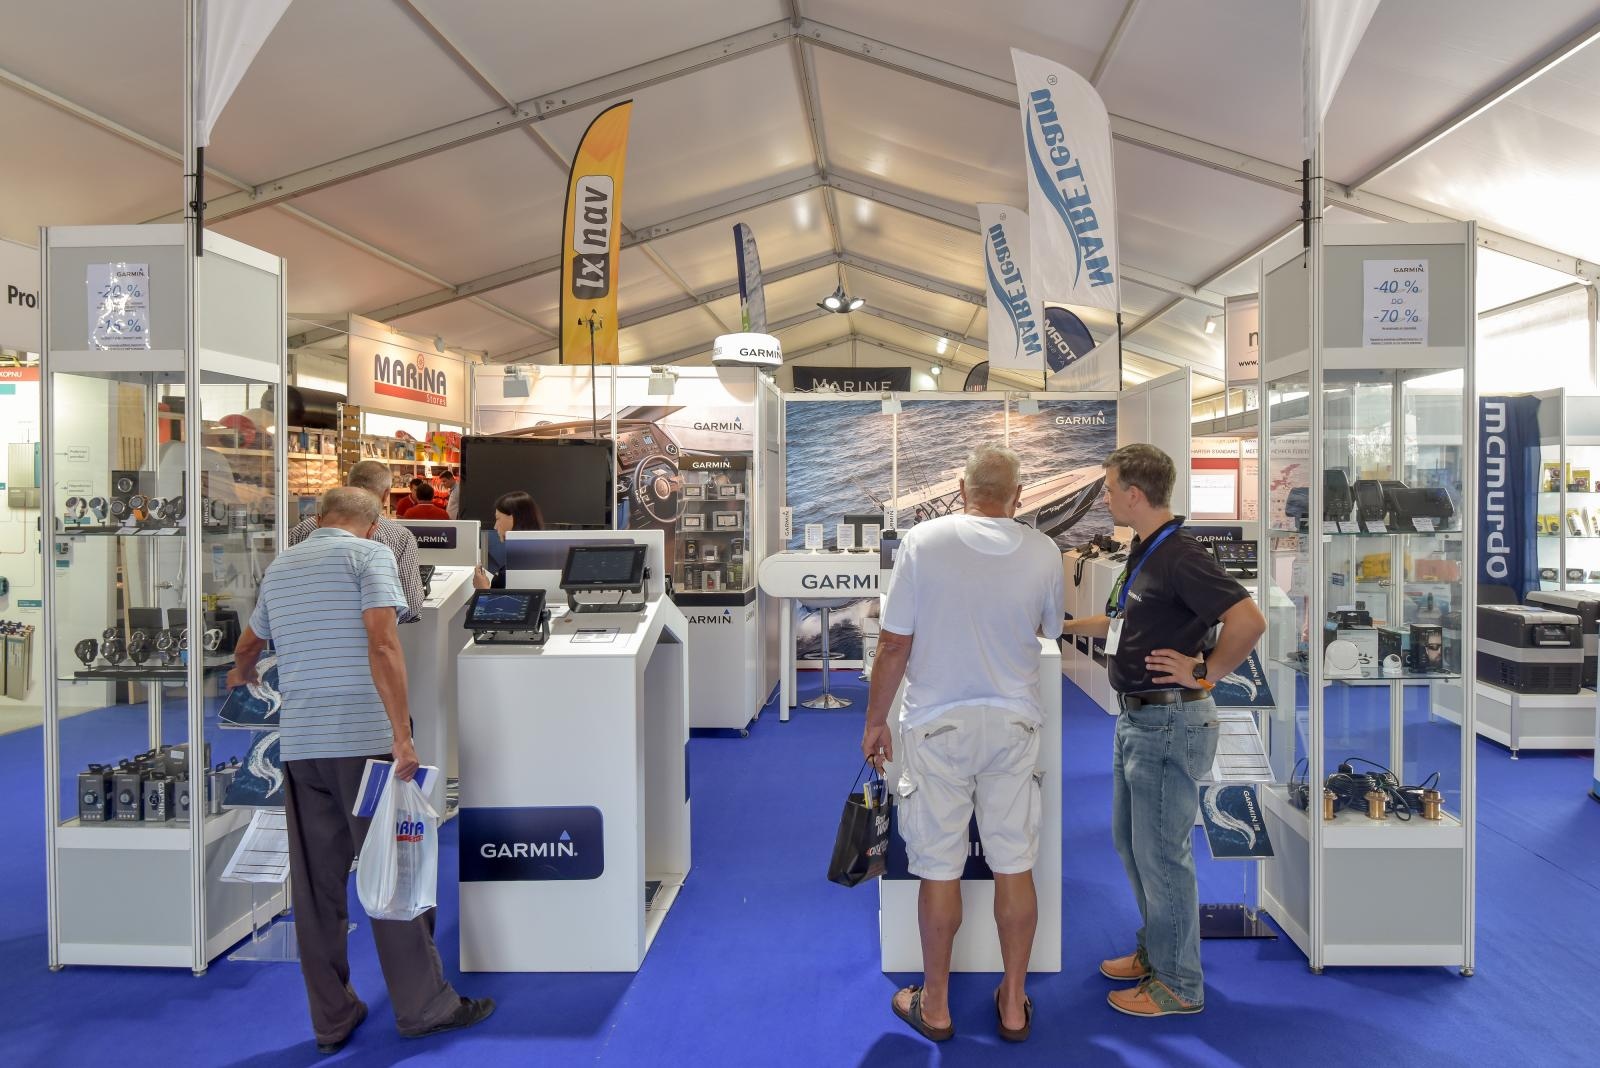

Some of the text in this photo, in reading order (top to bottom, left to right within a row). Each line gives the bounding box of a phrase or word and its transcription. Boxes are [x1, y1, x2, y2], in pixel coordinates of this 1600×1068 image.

[582, 186, 608, 248] nav
[127, 284, 141, 298] %
[1374, 280, 1419, 293] -40 %
[8, 284, 39, 309] Pro
[1373, 310, 1419, 323] -70 %
[127, 320, 142, 333] %
[739, 348, 782, 359] GARMIN
[693, 422, 744, 431] GARMIN
[1055, 416, 1106, 425] GARMIN
[1485, 402, 1510, 579] mcmurdo
[416, 535, 449, 543] ARMIN
[802, 574, 878, 589] GARMI
[1243, 790, 1258, 822] GARMIN
[480, 842, 577, 859] GARMIN
